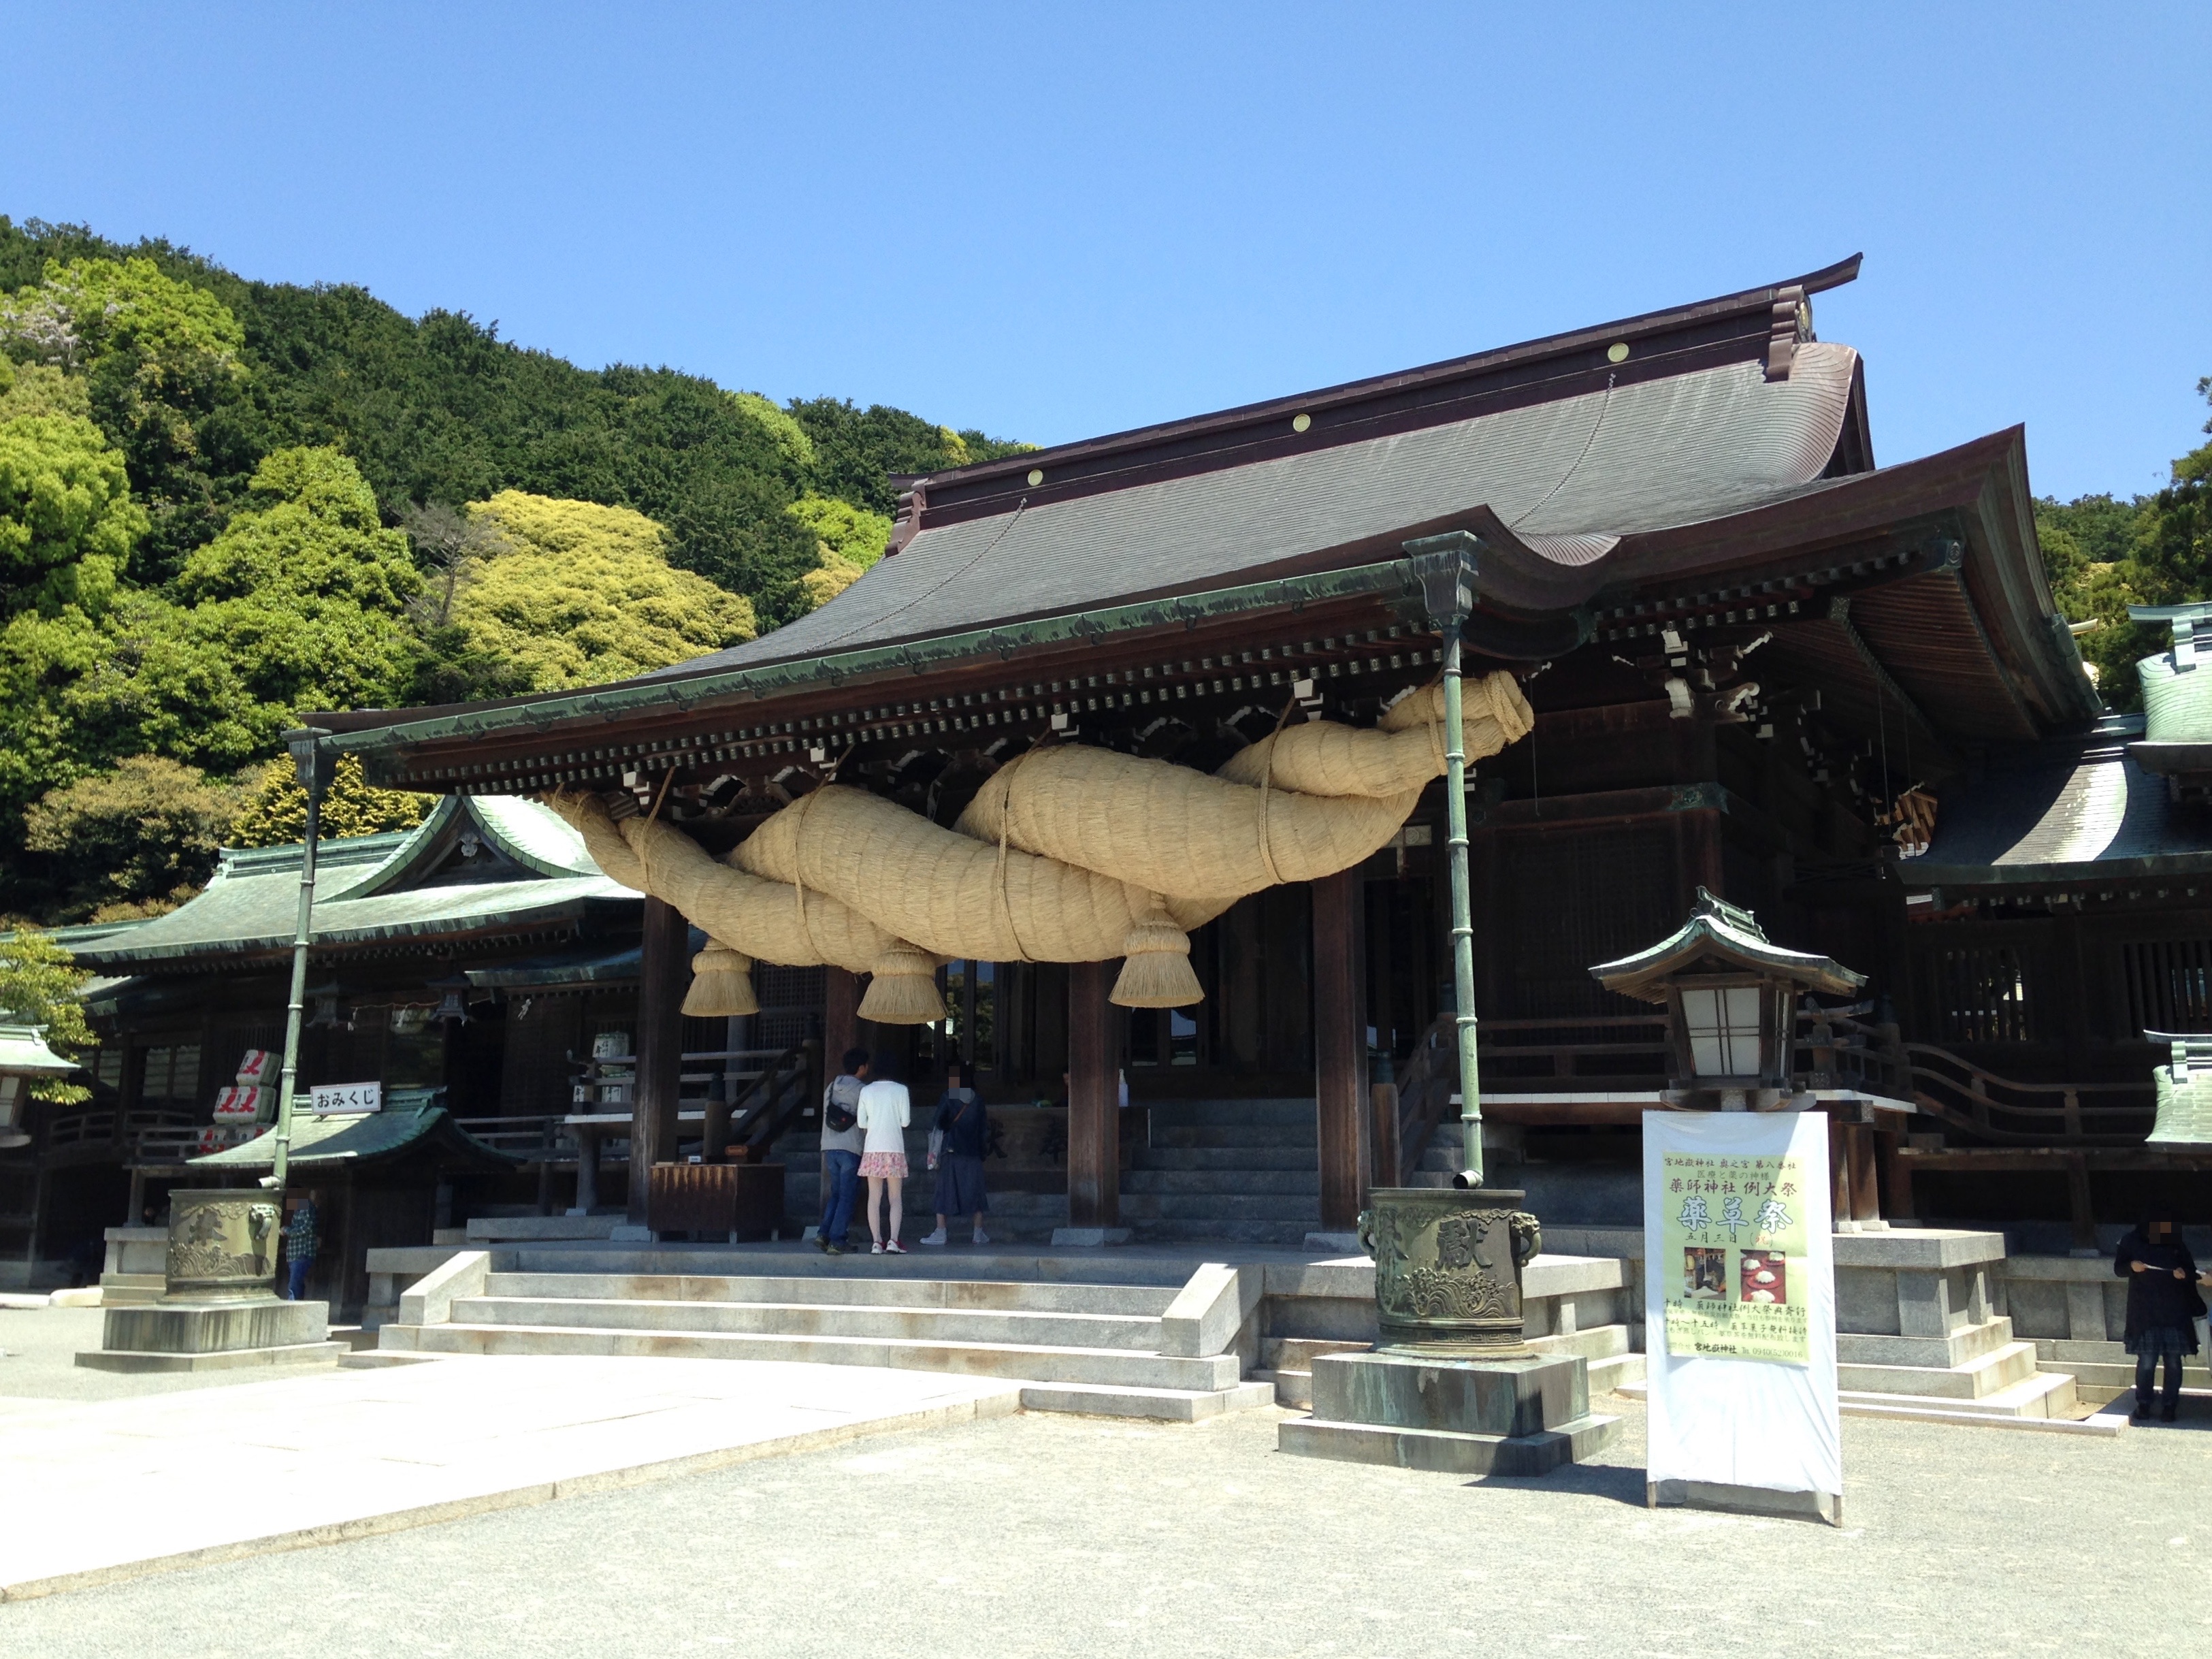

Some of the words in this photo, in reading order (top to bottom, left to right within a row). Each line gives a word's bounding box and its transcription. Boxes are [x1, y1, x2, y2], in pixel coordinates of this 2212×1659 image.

[317, 1089, 374, 1108] おみくじ
[1670, 1178, 1736, 1195] 薬師神社
[1744, 1182, 1797, 1197] 例大祭
[1676, 1195, 1793, 1234] 薬草祭
[1685, 1231, 1737, 1244] 五月三日
[1694, 1342, 1737, 1354] 宮地嶽神社
